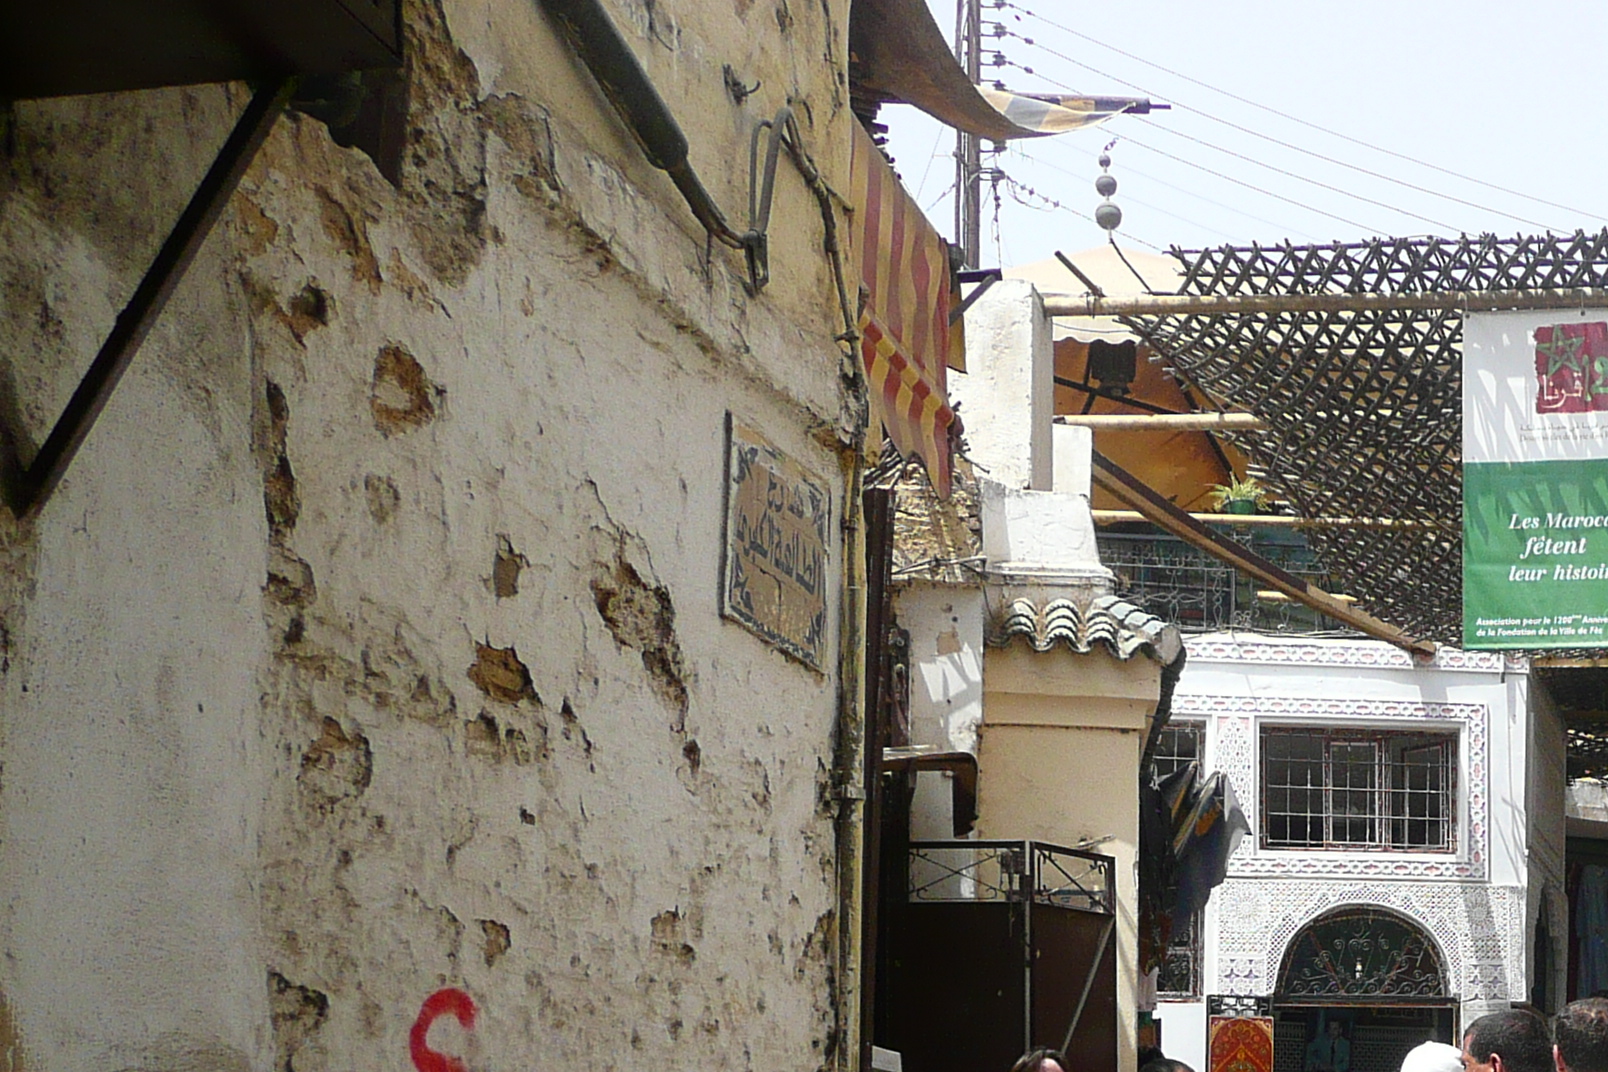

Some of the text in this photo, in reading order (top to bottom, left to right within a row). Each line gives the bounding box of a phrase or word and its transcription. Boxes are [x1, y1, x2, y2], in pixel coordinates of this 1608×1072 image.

[1540, 371, 1584, 409] قرنا
[1508, 513, 1540, 530] Les
[1519, 536, 1587, 559] fêtent
[1508, 565, 1548, 582] leur
[1476, 617, 1521, 626] Association
[1522, 618, 1542, 627] pour
[1543, 616, 1551, 625] le
[1476, 628, 1486, 636] de
[1487, 628, 1496, 636] la
[1497, 627, 1537, 636] Fondation
[1538, 627, 1548, 636] de
[1549, 627, 1558, 635] la
[1559, 627, 1576, 635] Ville
[1577, 626, 1588, 635] de
